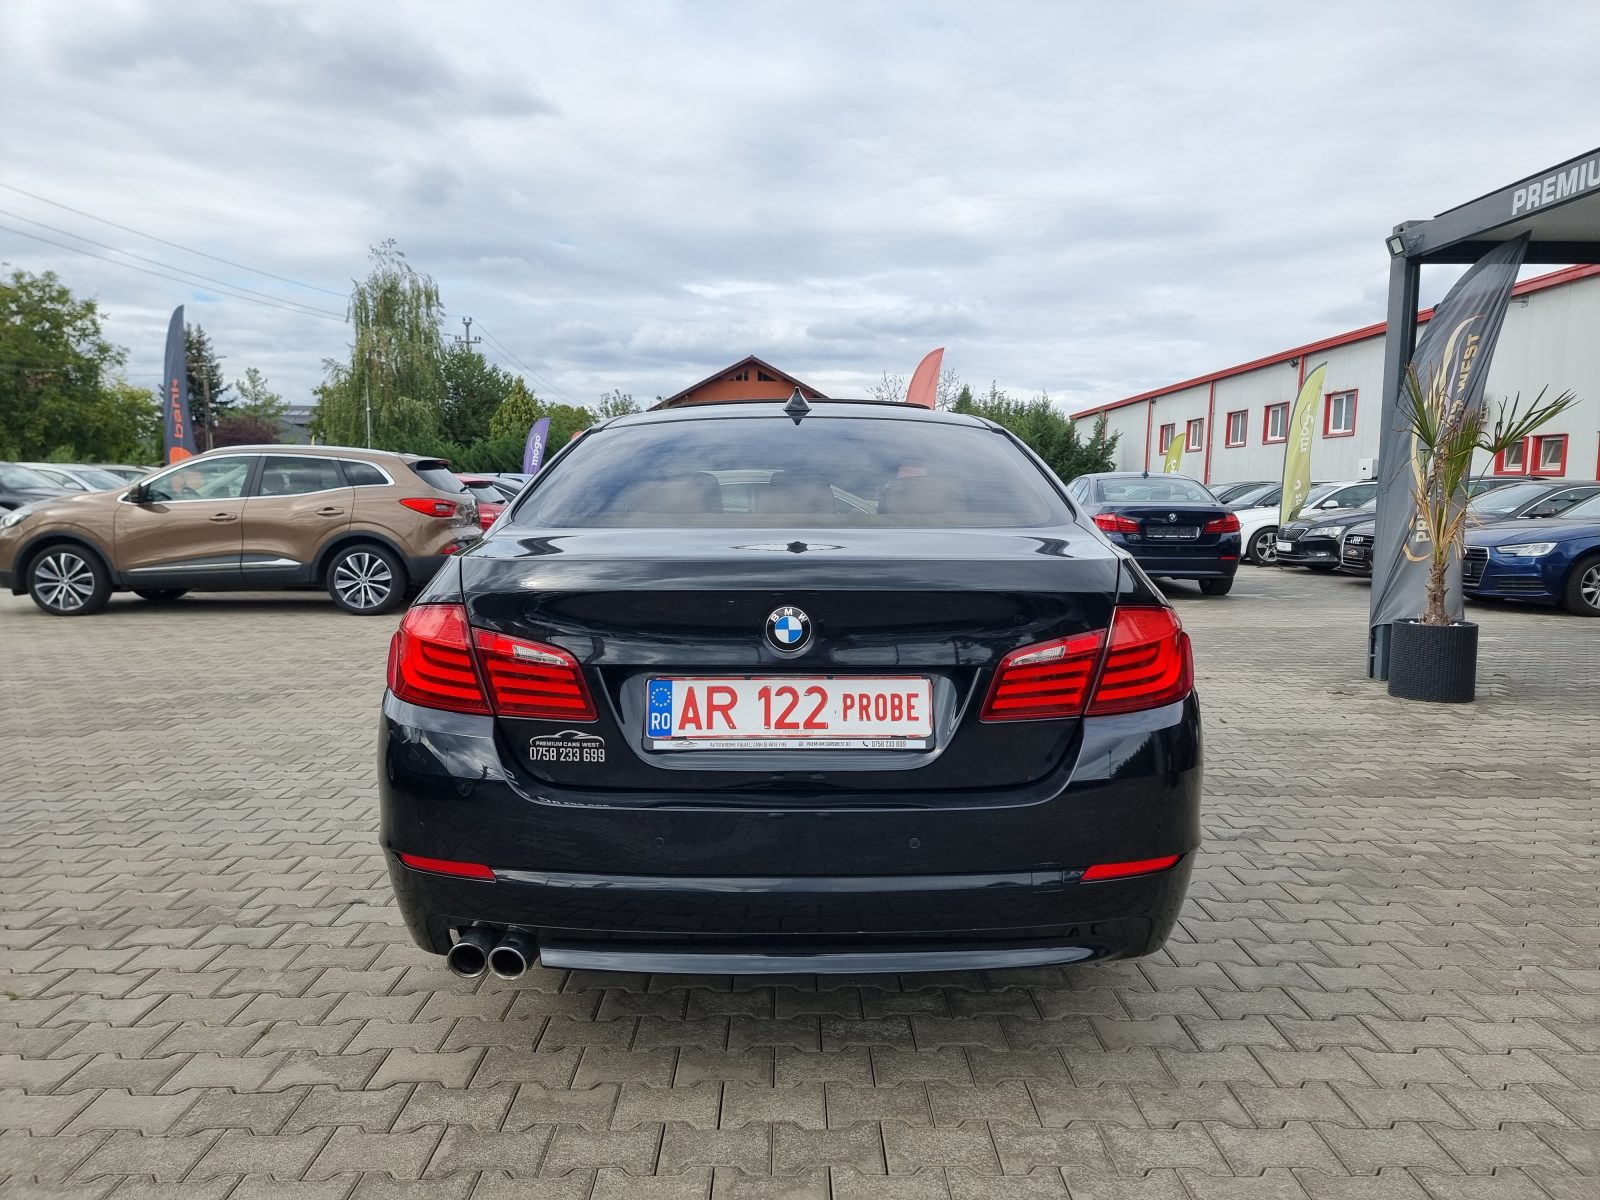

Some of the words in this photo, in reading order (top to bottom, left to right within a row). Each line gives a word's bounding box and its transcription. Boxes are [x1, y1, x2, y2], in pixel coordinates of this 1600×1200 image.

[1457, 333, 1480, 393] WEST
[531, 434, 542, 466] mogo
[770, 608, 808, 623] BMW
[678, 685, 738, 730] AR
[757, 685, 829, 730] 122
[842, 692, 920, 722] PROBE
[651, 712, 671, 730] RO
[529, 747, 557, 760] 0758
[559, 748, 580, 761] 233
[583, 748, 605, 762] 699
